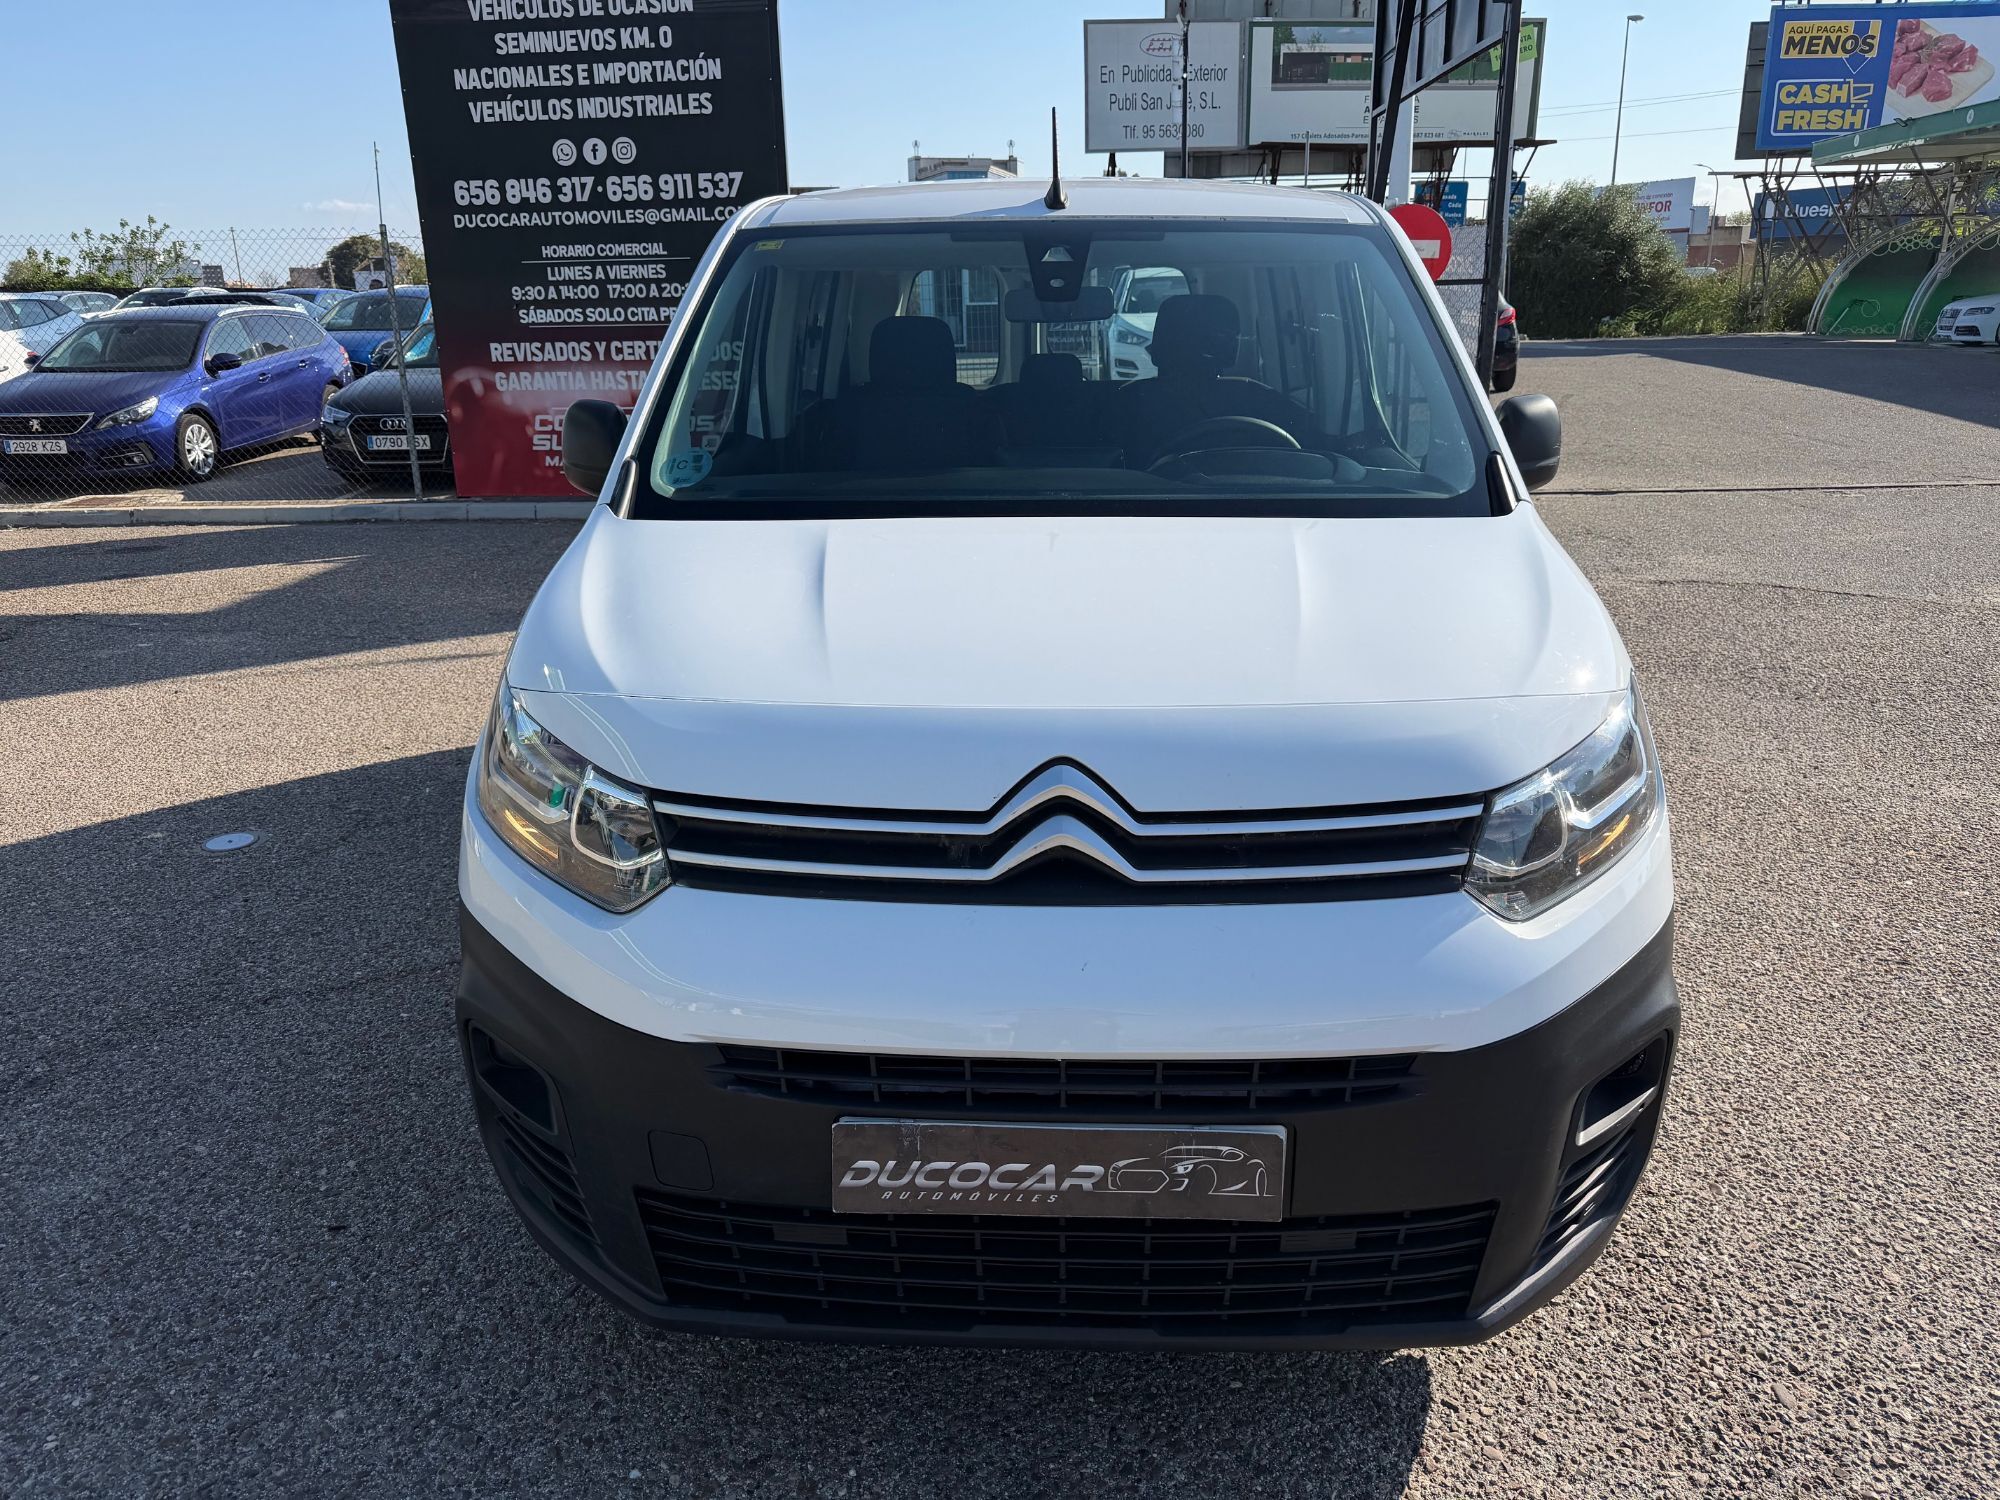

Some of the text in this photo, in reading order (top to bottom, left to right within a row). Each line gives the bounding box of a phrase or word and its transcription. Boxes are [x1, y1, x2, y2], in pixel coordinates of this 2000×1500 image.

[578, 0, 604, 17] DE
[1789, 24, 1849, 36] AQUÍ PAGAS
[494, 28, 616, 55] SEMINUEVOS
[621, 27, 655, 49] KM.
[1783, 34, 1877, 56] MENOS
[454, 53, 721, 90] NACIONALES E IMPORTACIÓN
[1100, 65, 1115, 83] En
[1122, 64, 1179, 83] Publicida
[1109, 93, 1137, 111] Publi
[1140, 92, 1163, 110] San
[1199, 91, 1221, 110] S.L.
[1780, 83, 1849, 105] CASH
[468, 93, 713, 123] VEHÍCULOS INDUSTRIALES
[1777, 108, 1864, 131] FRESH
[1122, 124, 1139, 139] Tlf.
[1142, 125, 1156, 138] 95
[453, 180, 501, 206] 656
[505, 177, 552, 204] 846
[659, 173, 694, 200] 911
[697, 172, 744, 198] 537
[453, 206, 741, 229] DUCOCARAUTOMOVILES@GMAIL.CO
[541, 243, 668, 258] HORARIO COMERCIAL
[547, 264, 666, 281] LUNES A VIERNES
[511, 286, 545, 301] 9:30
[547, 285, 558, 300] A
[559, 285, 600, 299] 14:00
[607, 284, 647, 299] 17:00
[648, 284, 660, 298] A
[518, 306, 584, 324] SÁBADOS
[586, 308, 625, 322] SOLO
[627, 307, 658, 321] CITA
[489, 342, 592, 362] REVISADOS
[595, 342, 607, 360] Y
[495, 371, 588, 392] GARANTIA
[12, 441, 62, 452] 2928 KZS
[375, 437, 403, 448] 0790
[839, 1160, 1105, 1192] DUCOCAR
[880, 1191, 1059, 1203] AUTOMÓVILES
